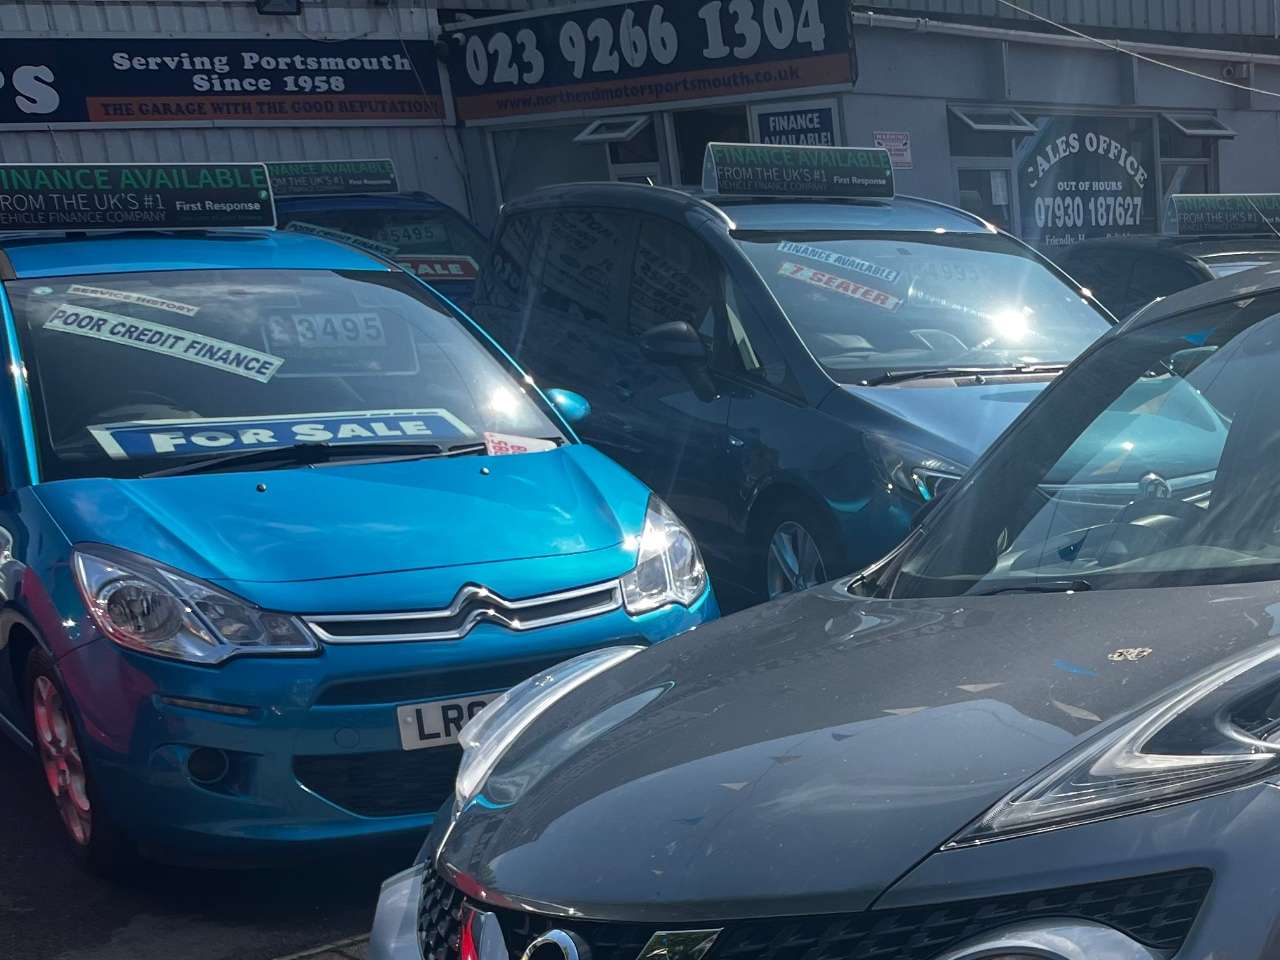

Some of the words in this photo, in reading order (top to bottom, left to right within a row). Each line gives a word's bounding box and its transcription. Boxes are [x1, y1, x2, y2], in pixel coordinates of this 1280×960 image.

[466, 28, 544, 85] 023
[560, 5, 678, 79] 9266
[698, 0, 825, 59] 1304
[112, 52, 230, 73] Serving
[241, 52, 412, 72] Portsmouth
[0, 65, 60, 114] S
[192, 74, 272, 92] Since
[283, 75, 345, 92] 1958
[496, 66, 801, 110] www.northendmotorsportsmouth.co.uk
[101, 103, 135, 116] THE
[139, 102, 208, 116] GARAGE
[210, 101, 253, 115] WITH
[256, 101, 288, 114] THE
[291, 101, 334, 113] GOOD
[769, 113, 821, 131] FINANCE
[716, 147, 793, 166] FINANCE
[798, 149, 890, 168] AVAILABLE
[1085, 132, 1148, 188] OFFICE
[119, 168, 268, 190] AVAILABLE
[718, 167, 752, 179] FROM
[757, 168, 780, 181] THE
[1057, 181, 1076, 191] OUT
[1079, 181, 1091, 191] OF
[1092, 181, 1123, 190] HOURS
[49, 194, 92, 211] THE
[95, 193, 139, 210] UK'S
[144, 193, 166, 210] #1
[175, 201, 201, 211] First
[205, 200, 261, 213] Response
[1034, 196, 1083, 228] 07930
[1088, 196, 1142, 227] 187627
[781, 242, 832, 262] FINANCE
[833, 253, 894, 282] AVAILABLE
[72, 286, 132, 301] SERVICE
[135, 296, 194, 314] HISTORY
[809, 271, 889, 306] SEATER
[49, 309, 106, 332] POOR
[109, 320, 185, 349] CREDIT
[183, 340, 274, 376] FINANCE
[150, 428, 278, 454] FOR
[290, 420, 432, 443] SALE
